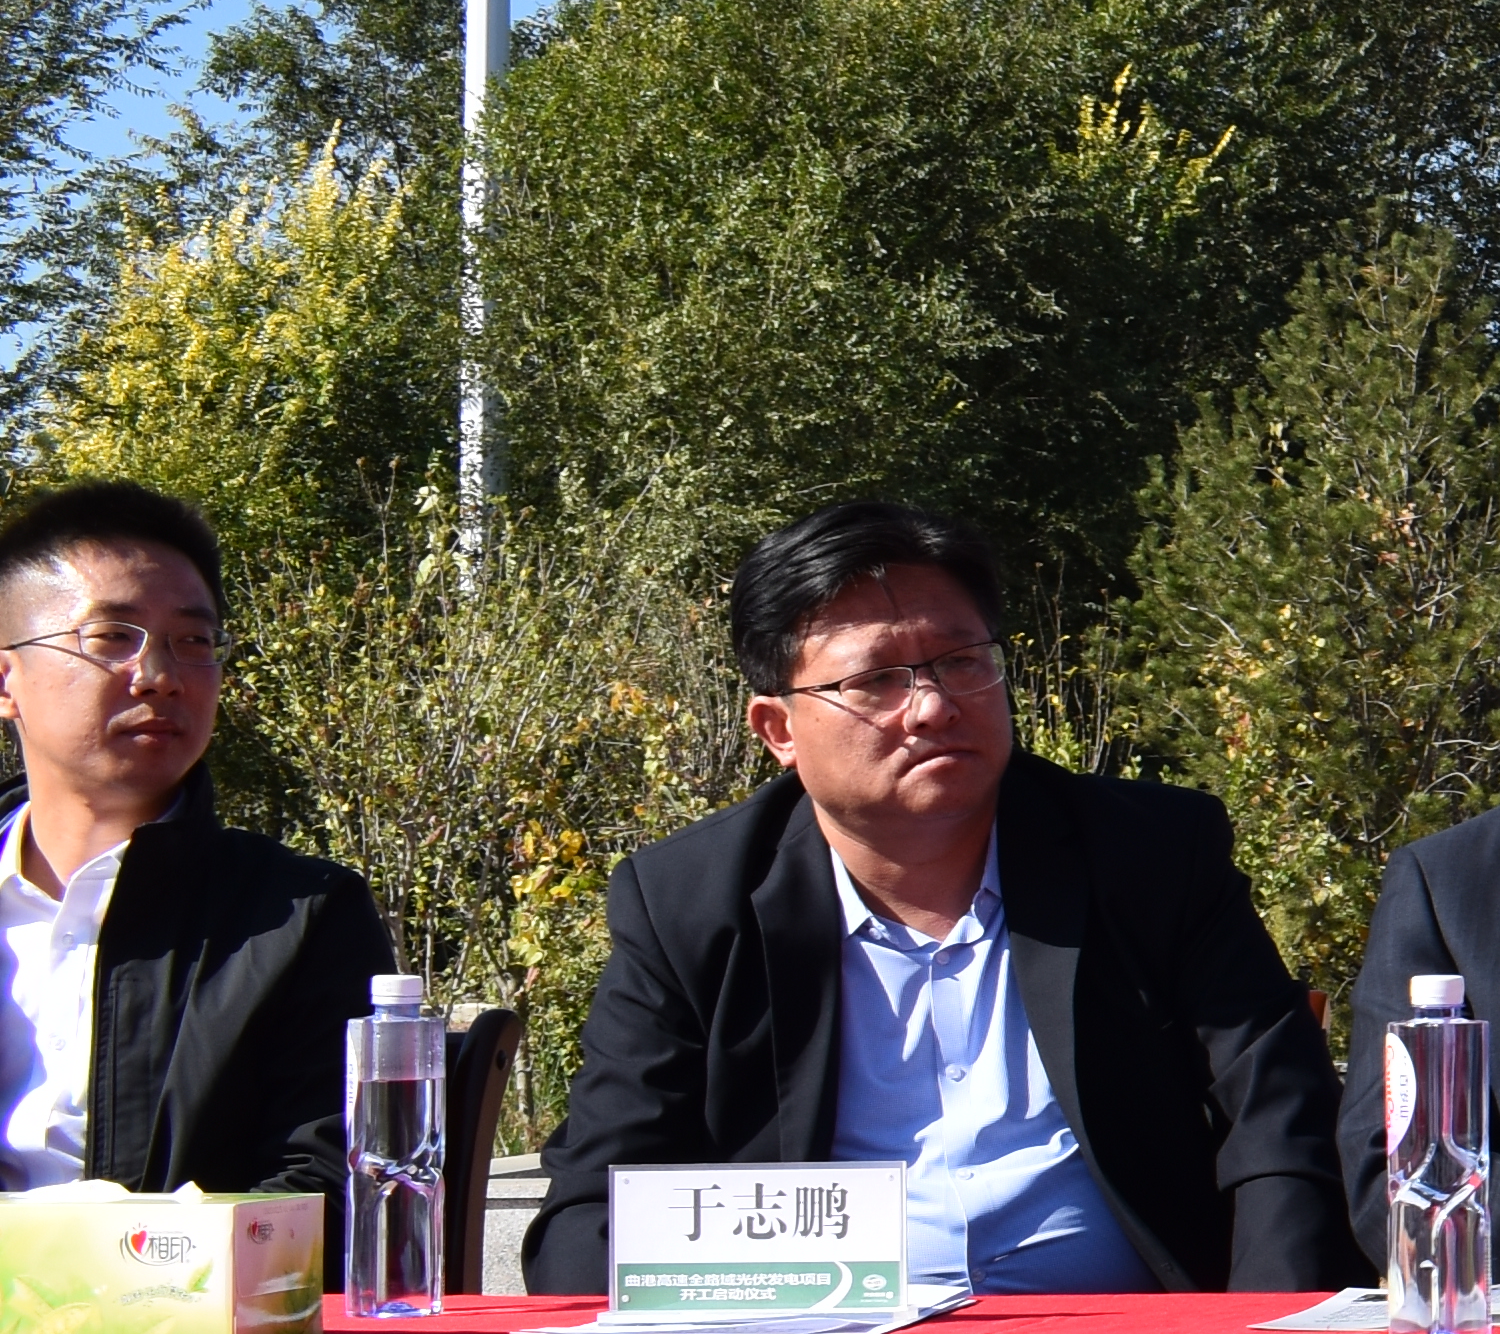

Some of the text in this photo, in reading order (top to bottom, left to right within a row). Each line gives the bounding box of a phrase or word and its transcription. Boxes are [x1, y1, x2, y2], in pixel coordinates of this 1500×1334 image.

[668, 1182, 850, 1242] 于志鹏
[624, 1273, 831, 1288] 曲港高速全路域光伏发电项目
[679, 1288, 777, 1302] 开工启动仪式
